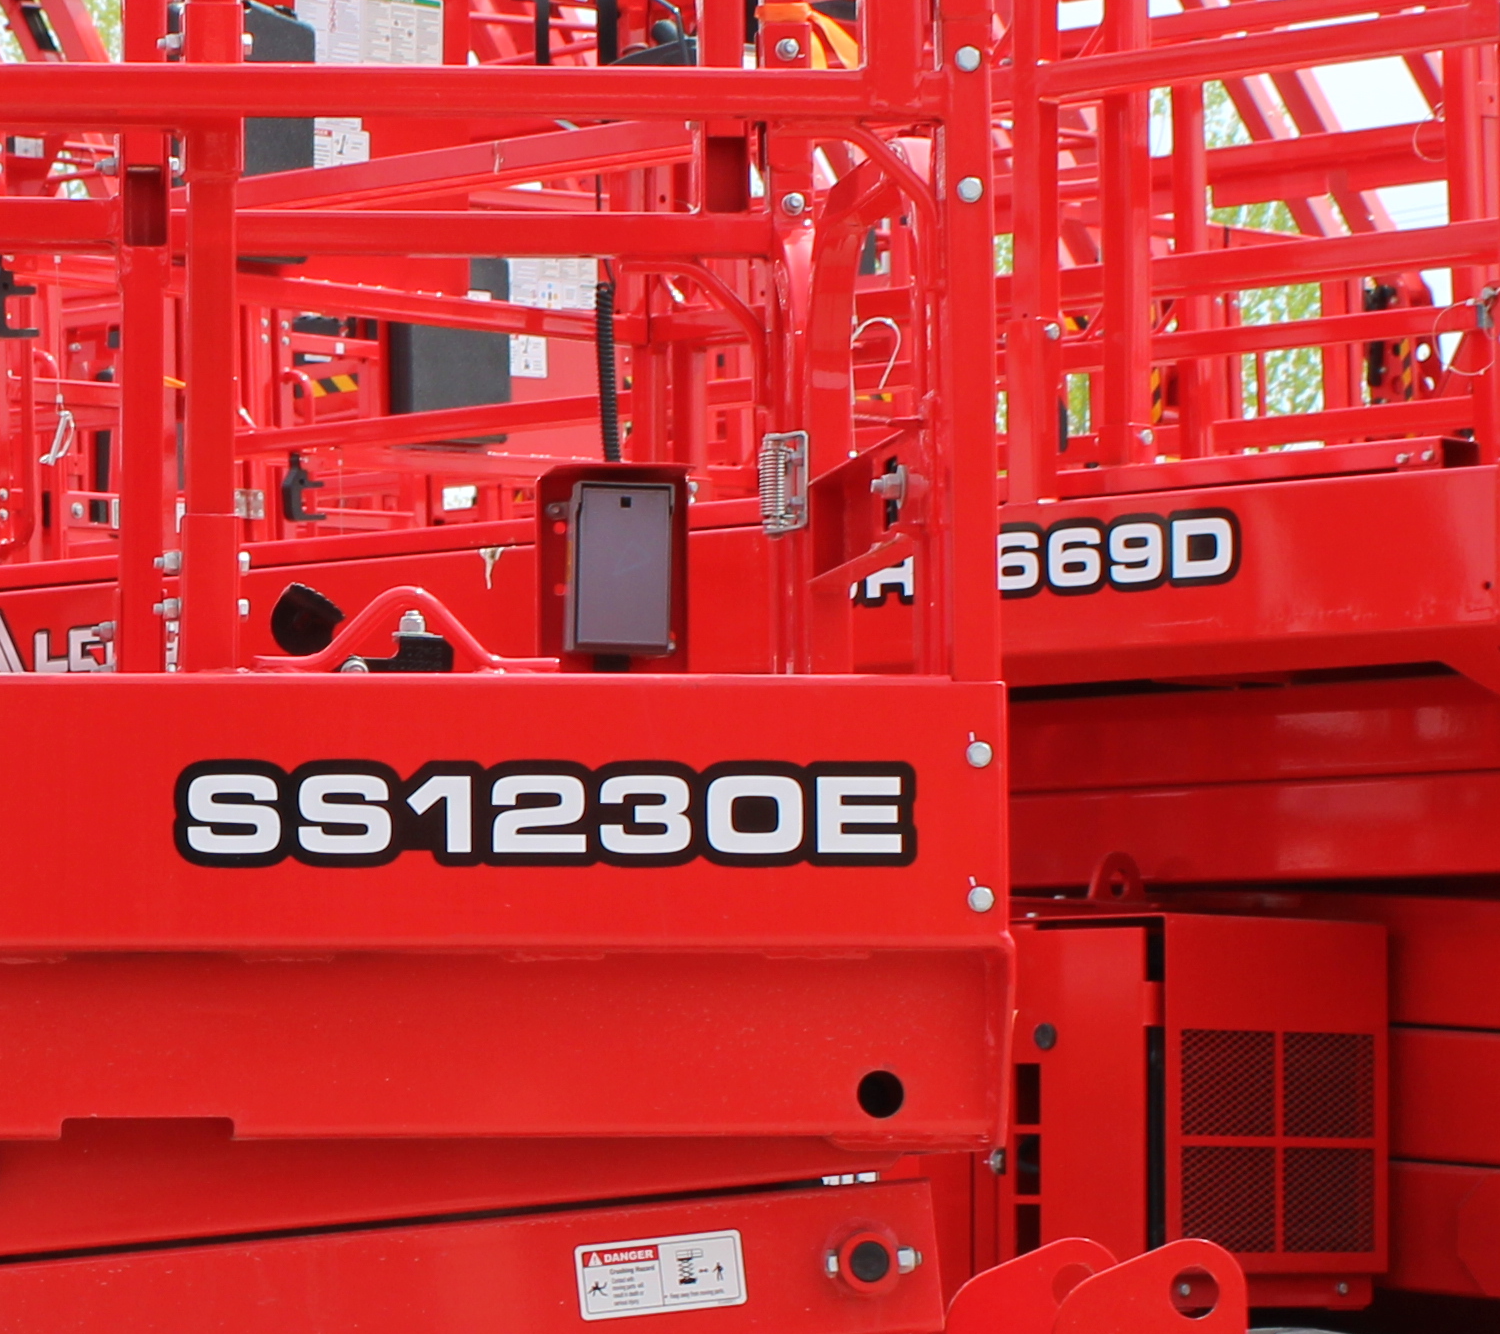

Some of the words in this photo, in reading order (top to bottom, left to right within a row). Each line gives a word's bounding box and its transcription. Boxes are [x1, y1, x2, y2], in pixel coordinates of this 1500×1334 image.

[183, 772, 907, 856] SS1230E
[604, 1250, 654, 1263] DANGER
[610, 1267, 634, 1275] Crushing
